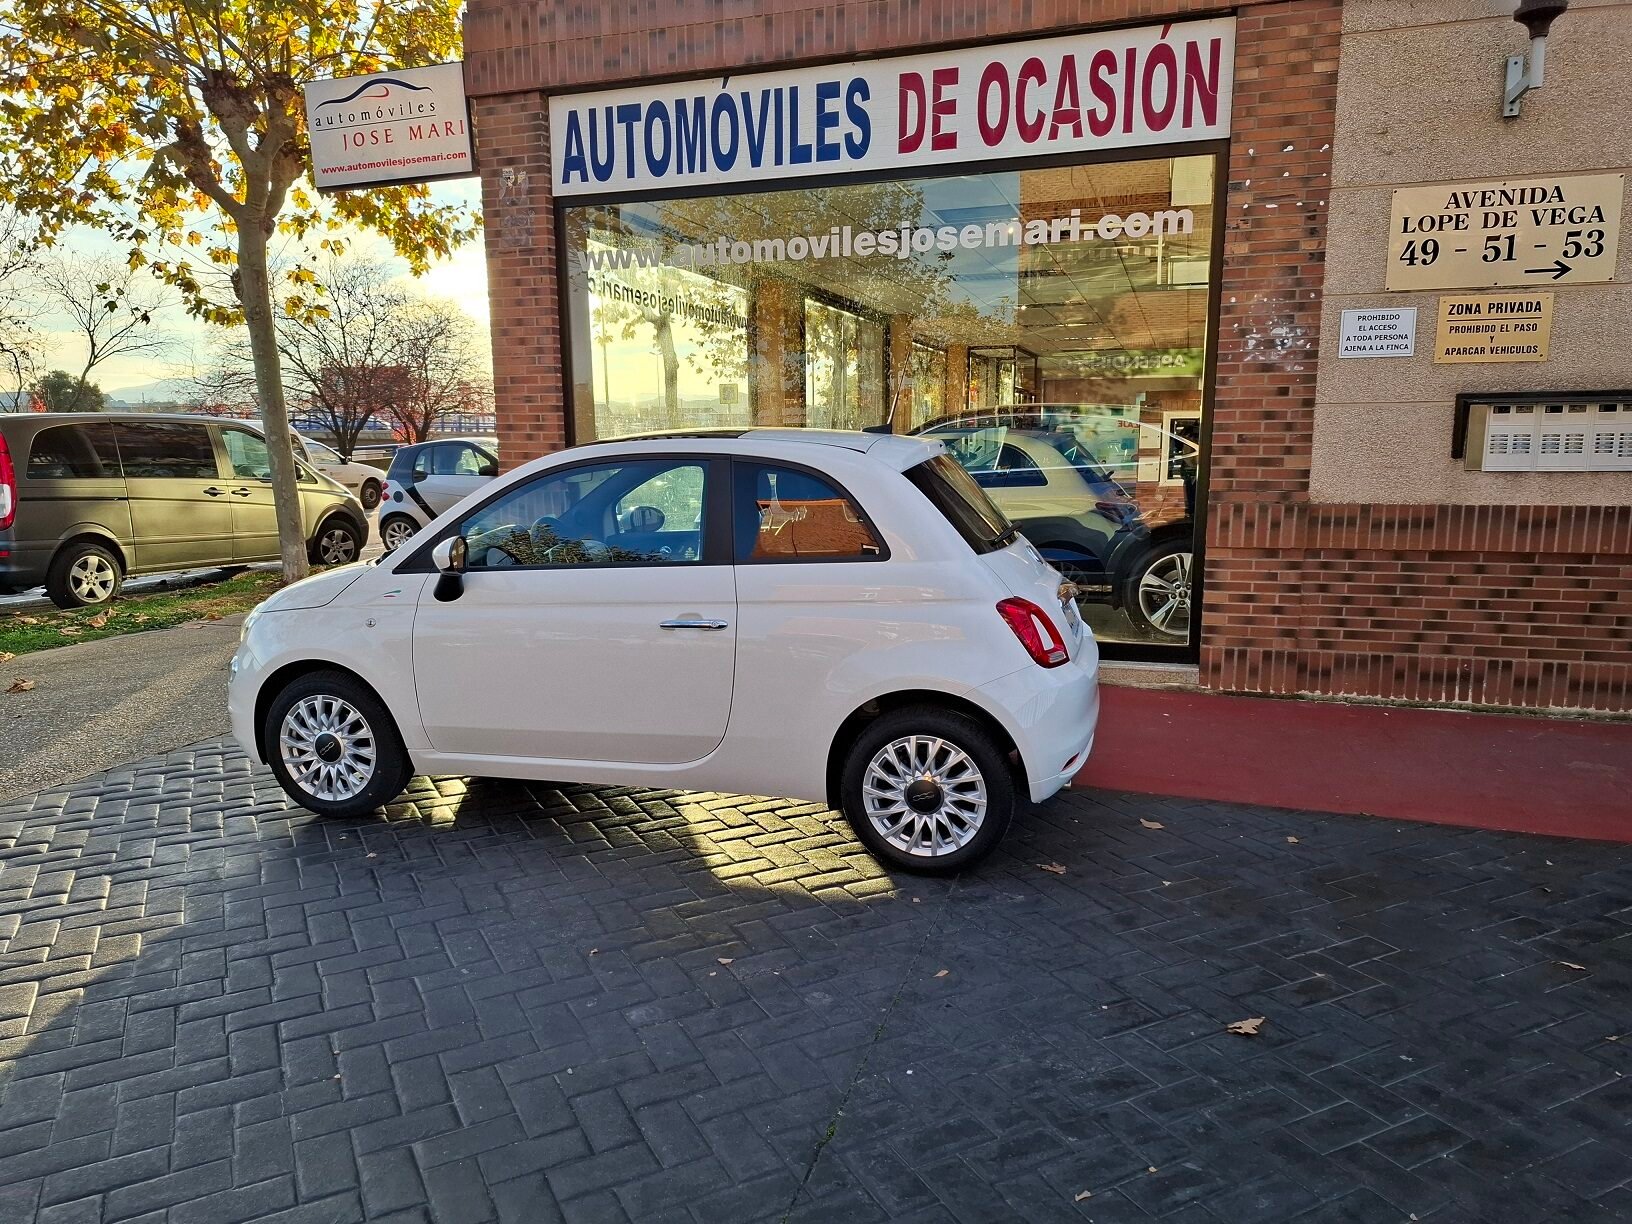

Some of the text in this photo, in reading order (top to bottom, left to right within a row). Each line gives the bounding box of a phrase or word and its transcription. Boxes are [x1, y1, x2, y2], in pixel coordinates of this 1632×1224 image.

[315, 101, 436, 127] automóviles
[561, 23, 1222, 185] AUTOMÓVILES DE OCASIÓN
[343, 119, 465, 151] JOSE MARI
[321, 151, 467, 175] www.automovilesjosemari.com
[1444, 185, 1566, 210] AVENIDA
[1401, 205, 1606, 234] LOPE DE VEGA
[577, 208, 1193, 272] www.automovilesjosemari.com
[1399, 238, 1440, 267] 49
[1481, 233, 1518, 263] 51
[1562, 229, 1606, 259] 53
[1357, 313, 1401, 322] PROHIBIDO
[1448, 301, 1542, 316] ZONA PRIVADA
[1368, 323, 1398, 331] ACCESO
[1374, 333, 1409, 341] PERSONA
[1449, 323, 1538, 334] PROHIBIDO EL PASO
[1386, 343, 1409, 351] FINCA
[1445, 345, 1539, 356] APARCAR VEHICULOS
